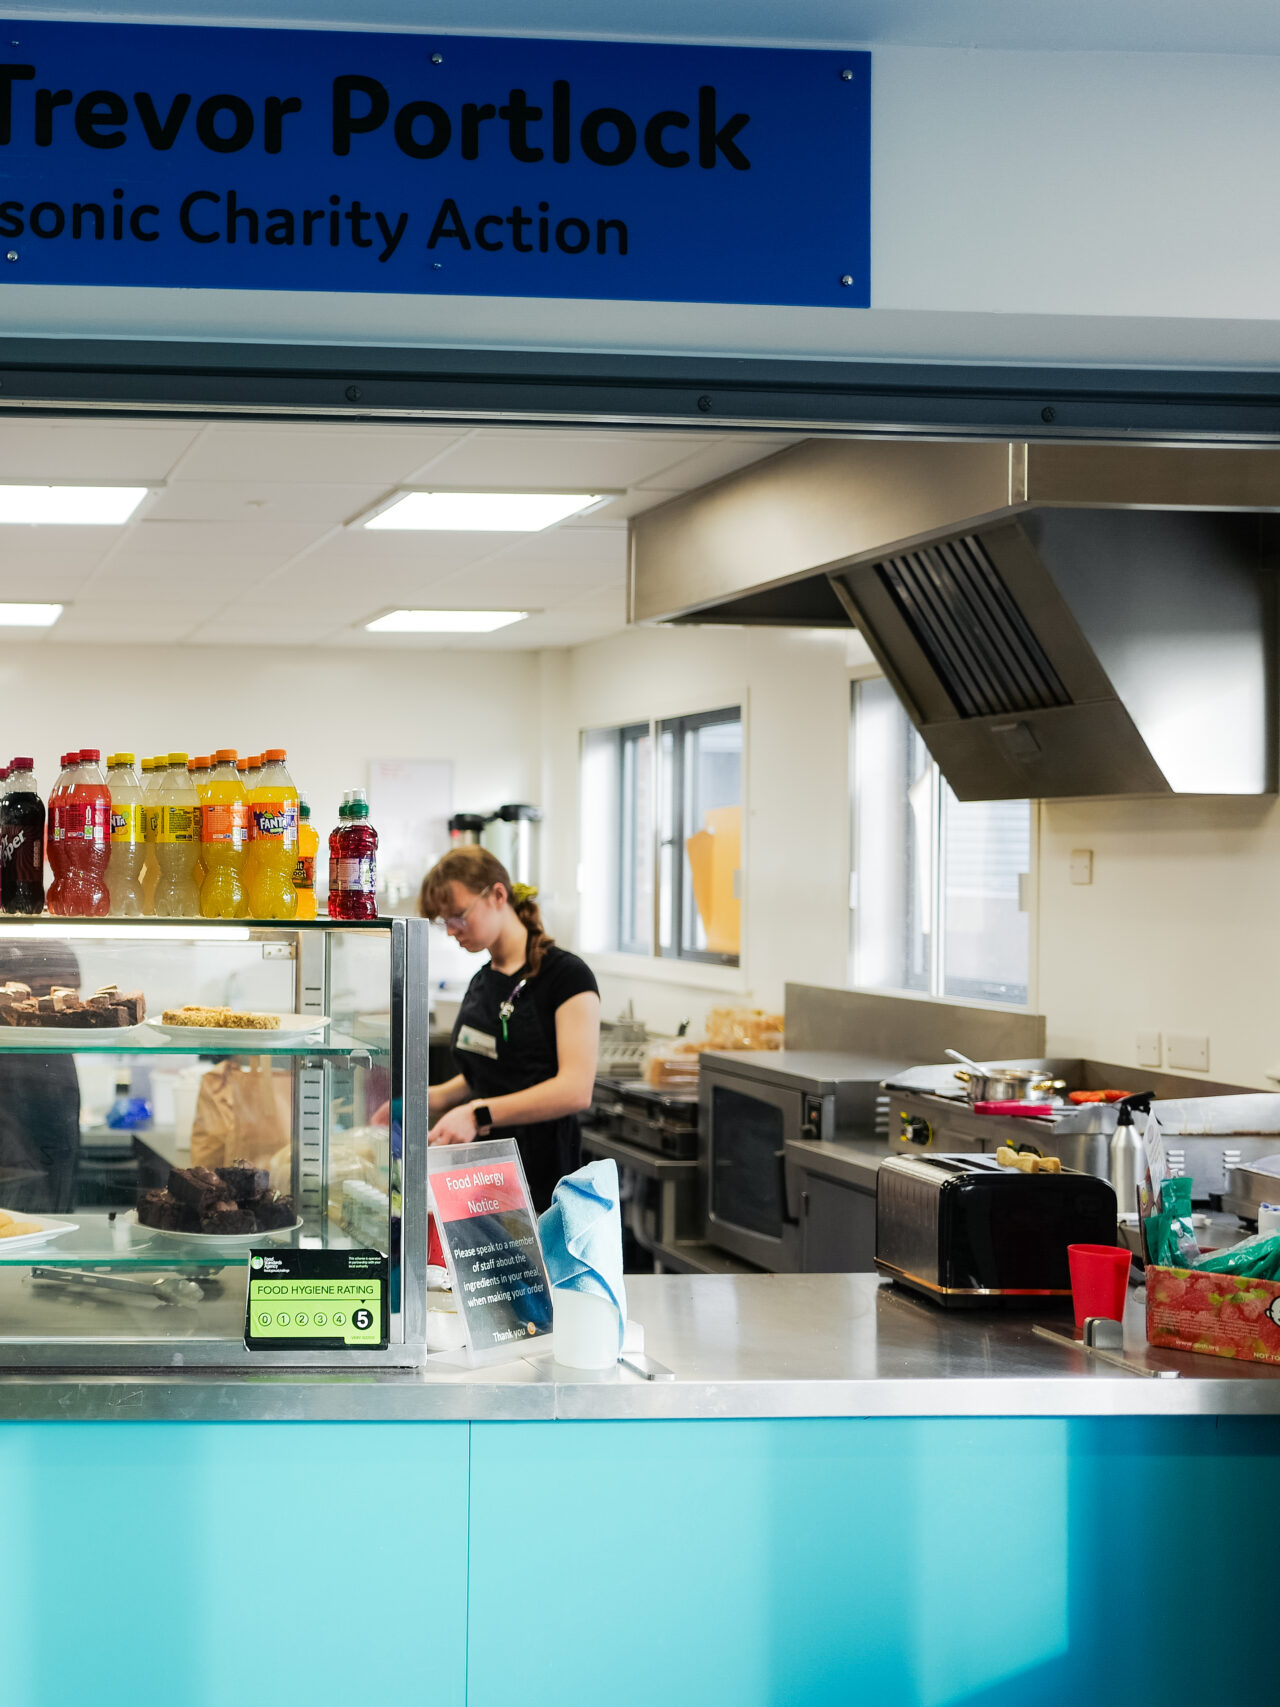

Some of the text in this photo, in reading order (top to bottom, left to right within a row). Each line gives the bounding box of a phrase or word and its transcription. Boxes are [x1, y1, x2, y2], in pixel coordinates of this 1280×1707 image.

[331, 73, 752, 171] Portlock
[178, 189, 410, 263] Charity
[427, 199, 630, 257] Action
[446, 1170, 505, 1191] Food Allergy
[468, 1198, 499, 1214] Notice
[454, 1248, 475, 1259] Please
[476, 1244, 495, 1256] speak
[496, 1243, 502, 1251] to
[509, 1237, 534, 1247] member
[473, 1254, 526, 1272] of staff about the
[464, 1268, 541, 1292] ingredients in your meal,
[258, 1286, 374, 1295] FOOD HYGIENE RATING
[468, 1284, 544, 1308] when making your order
[299, 1315, 305, 1323] 2
[317, 1315, 323, 1323] 3
[336, 1315, 342, 1323] 4
[357, 1311, 368, 1328] 5
[493, 1327, 525, 1342] Thank you
[1253, 1352, 1269, 1360] NOT
